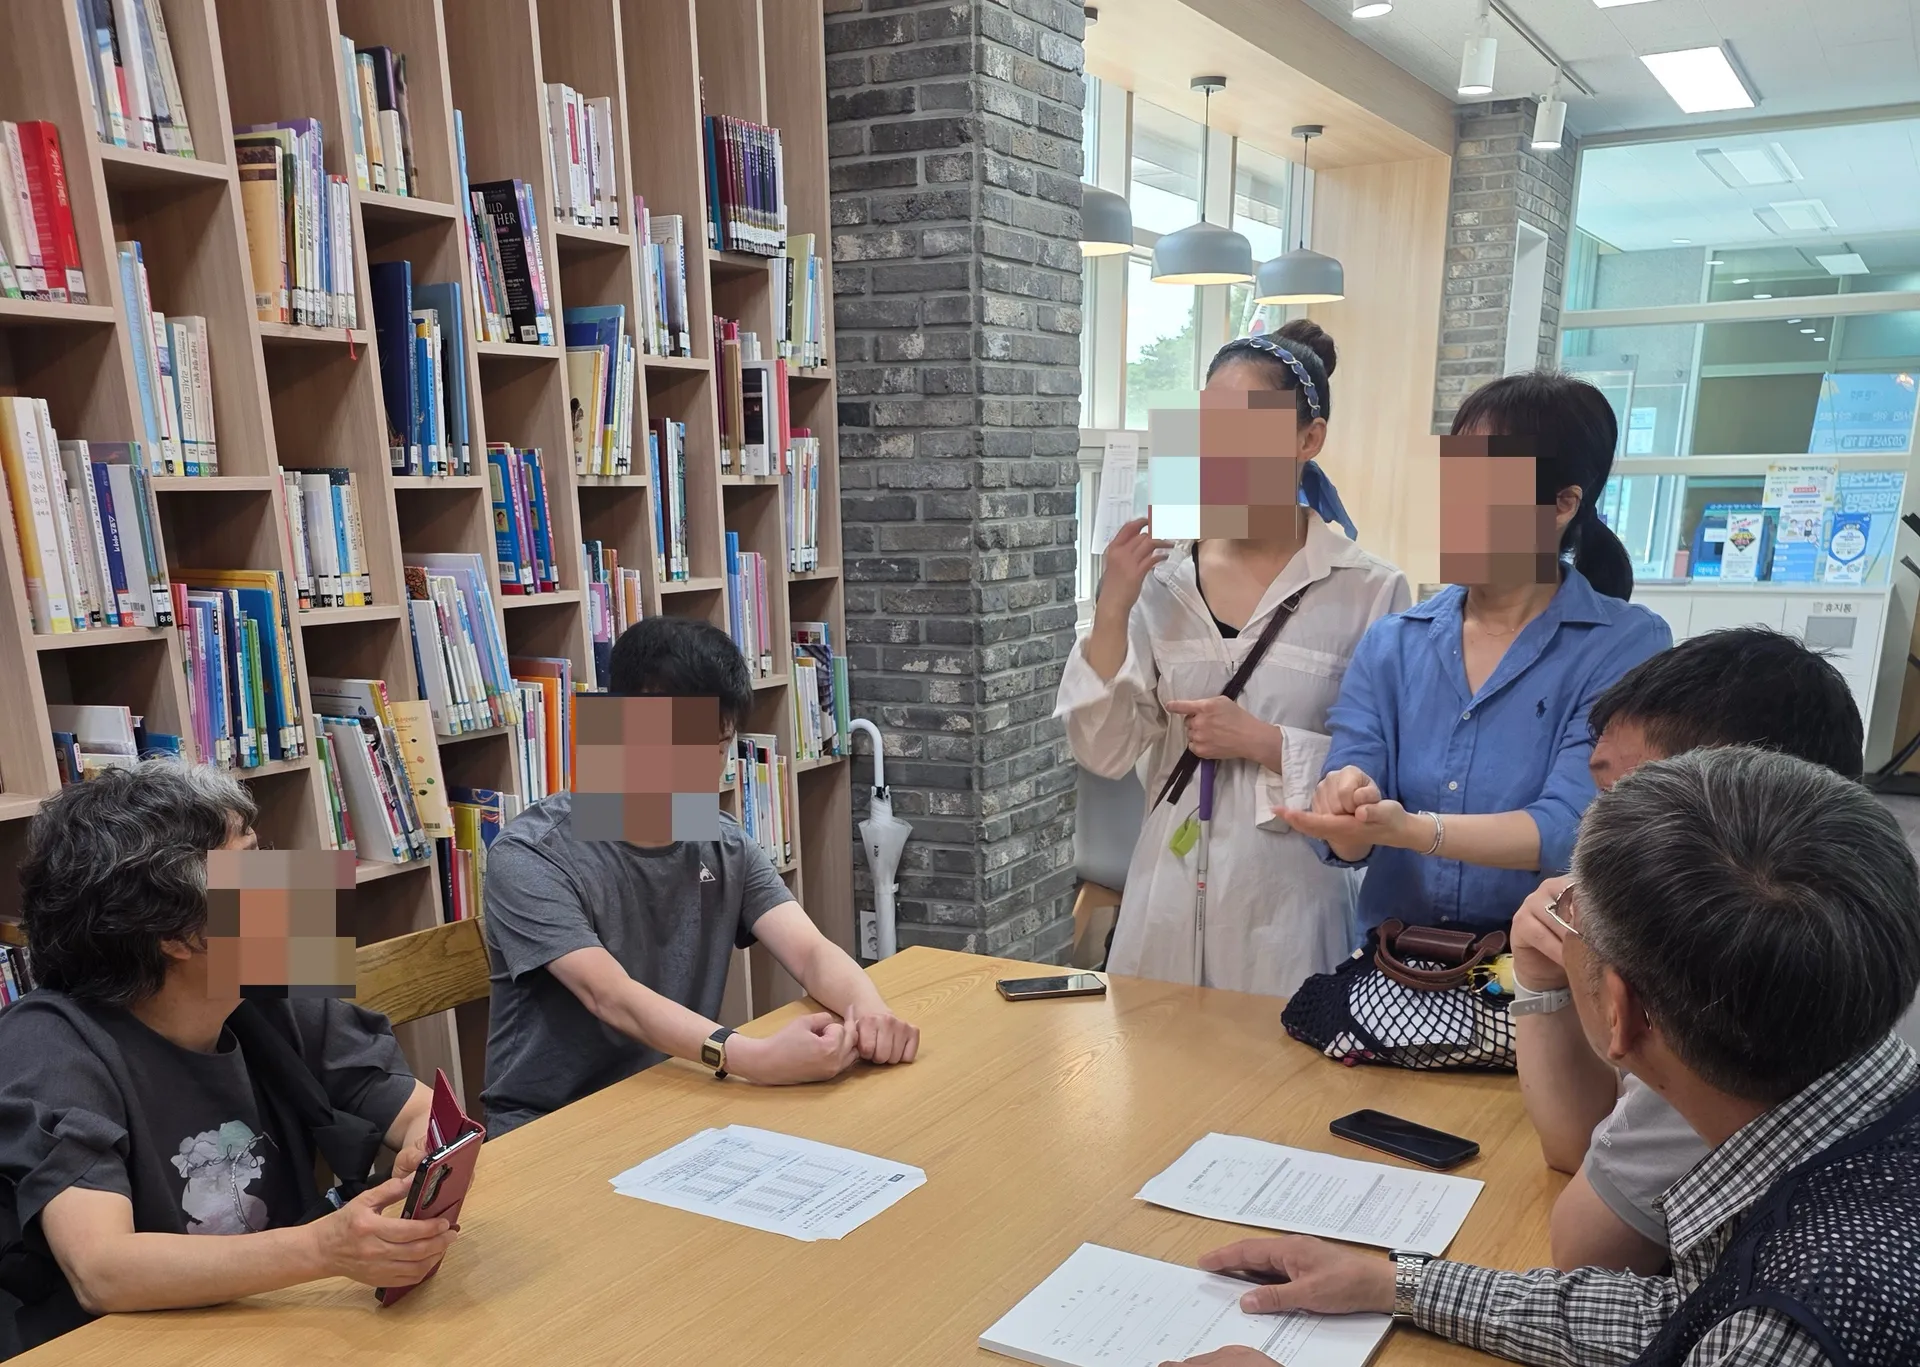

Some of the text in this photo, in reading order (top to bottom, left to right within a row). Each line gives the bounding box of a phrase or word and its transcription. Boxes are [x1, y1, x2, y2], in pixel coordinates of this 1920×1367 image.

[29, 470, 43, 480] 임신
[34, 497, 48, 506] 육아
[1825, 602, 1852, 614] 휴지통
